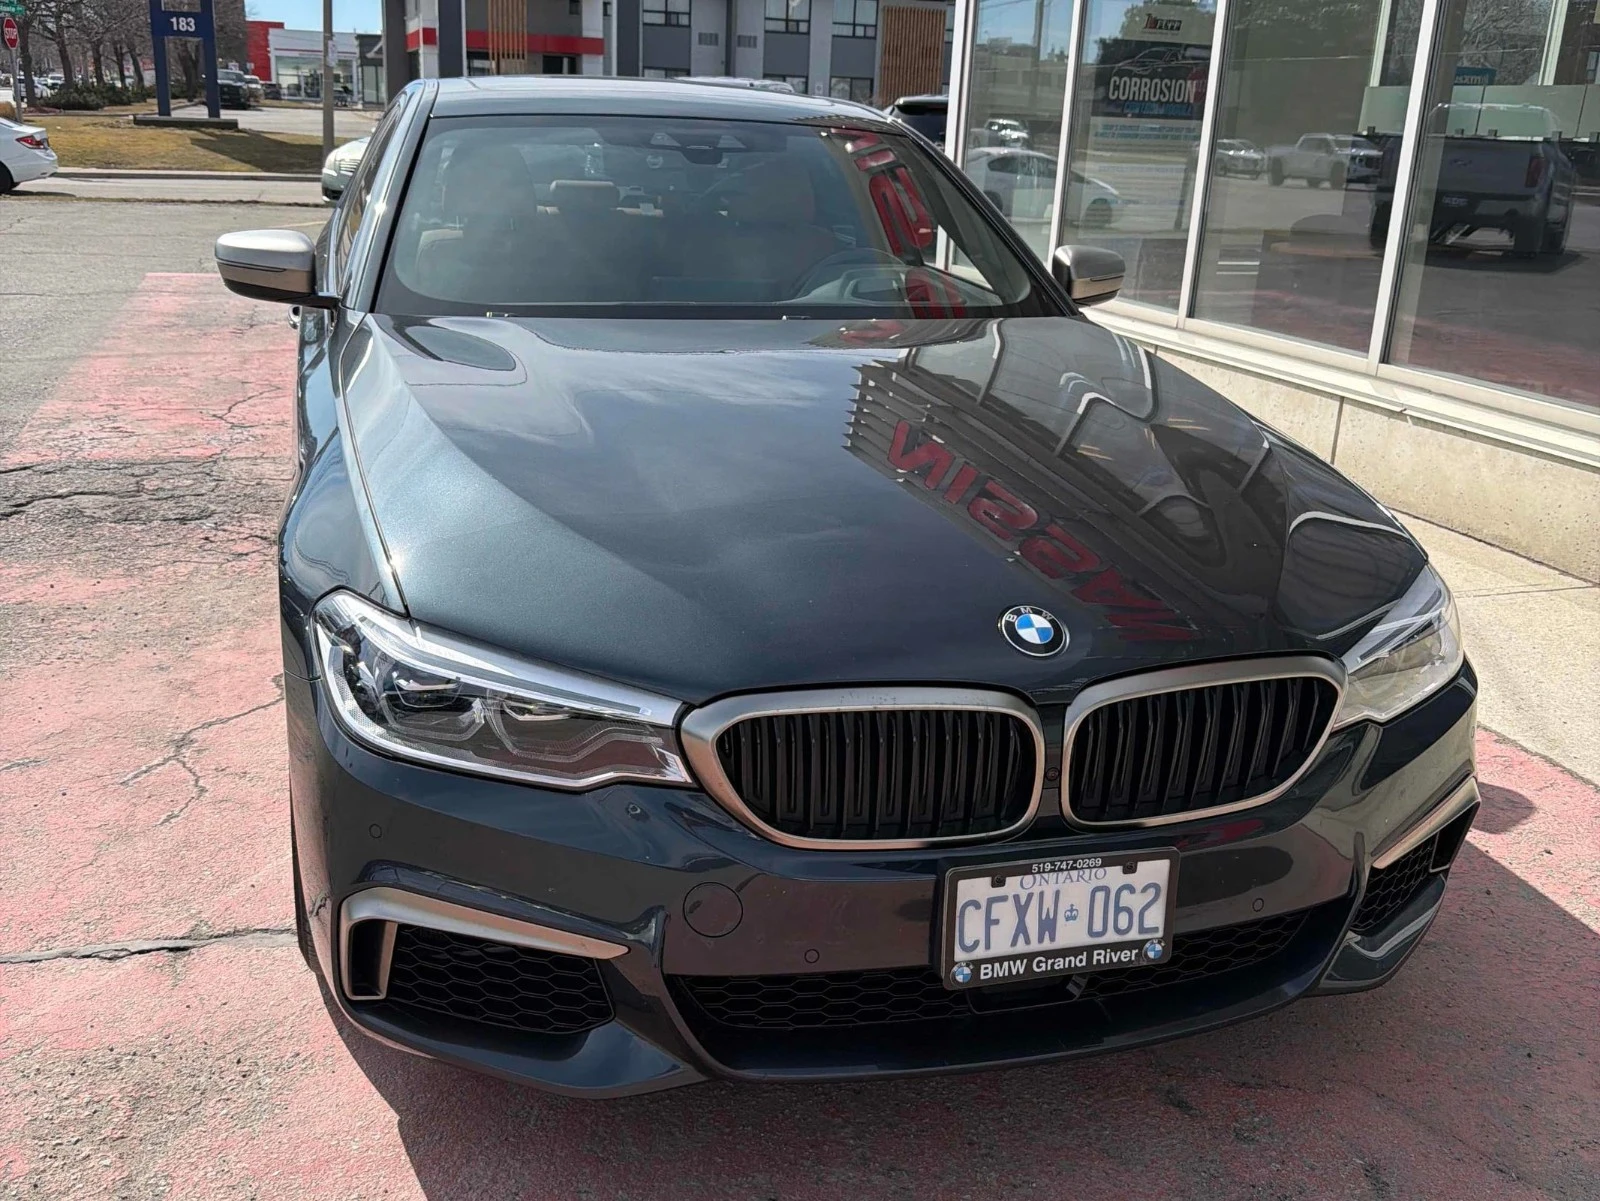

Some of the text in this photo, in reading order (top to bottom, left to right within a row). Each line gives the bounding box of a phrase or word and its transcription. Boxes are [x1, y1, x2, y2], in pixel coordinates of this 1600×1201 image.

[169, 16, 196, 32] 183
[1108, 76, 1196, 103] CORROSION
[1006, 606, 1053, 622] BMW
[1031, 857, 1102, 873] 519-747-0269
[1019, 867, 1107, 890] ONTARIO
[958, 882, 1162, 953] CFXW 062
[980, 958, 1028, 980] BMW
[1032, 951, 1087, 973] Grand
[1092, 948, 1139, 966] River
